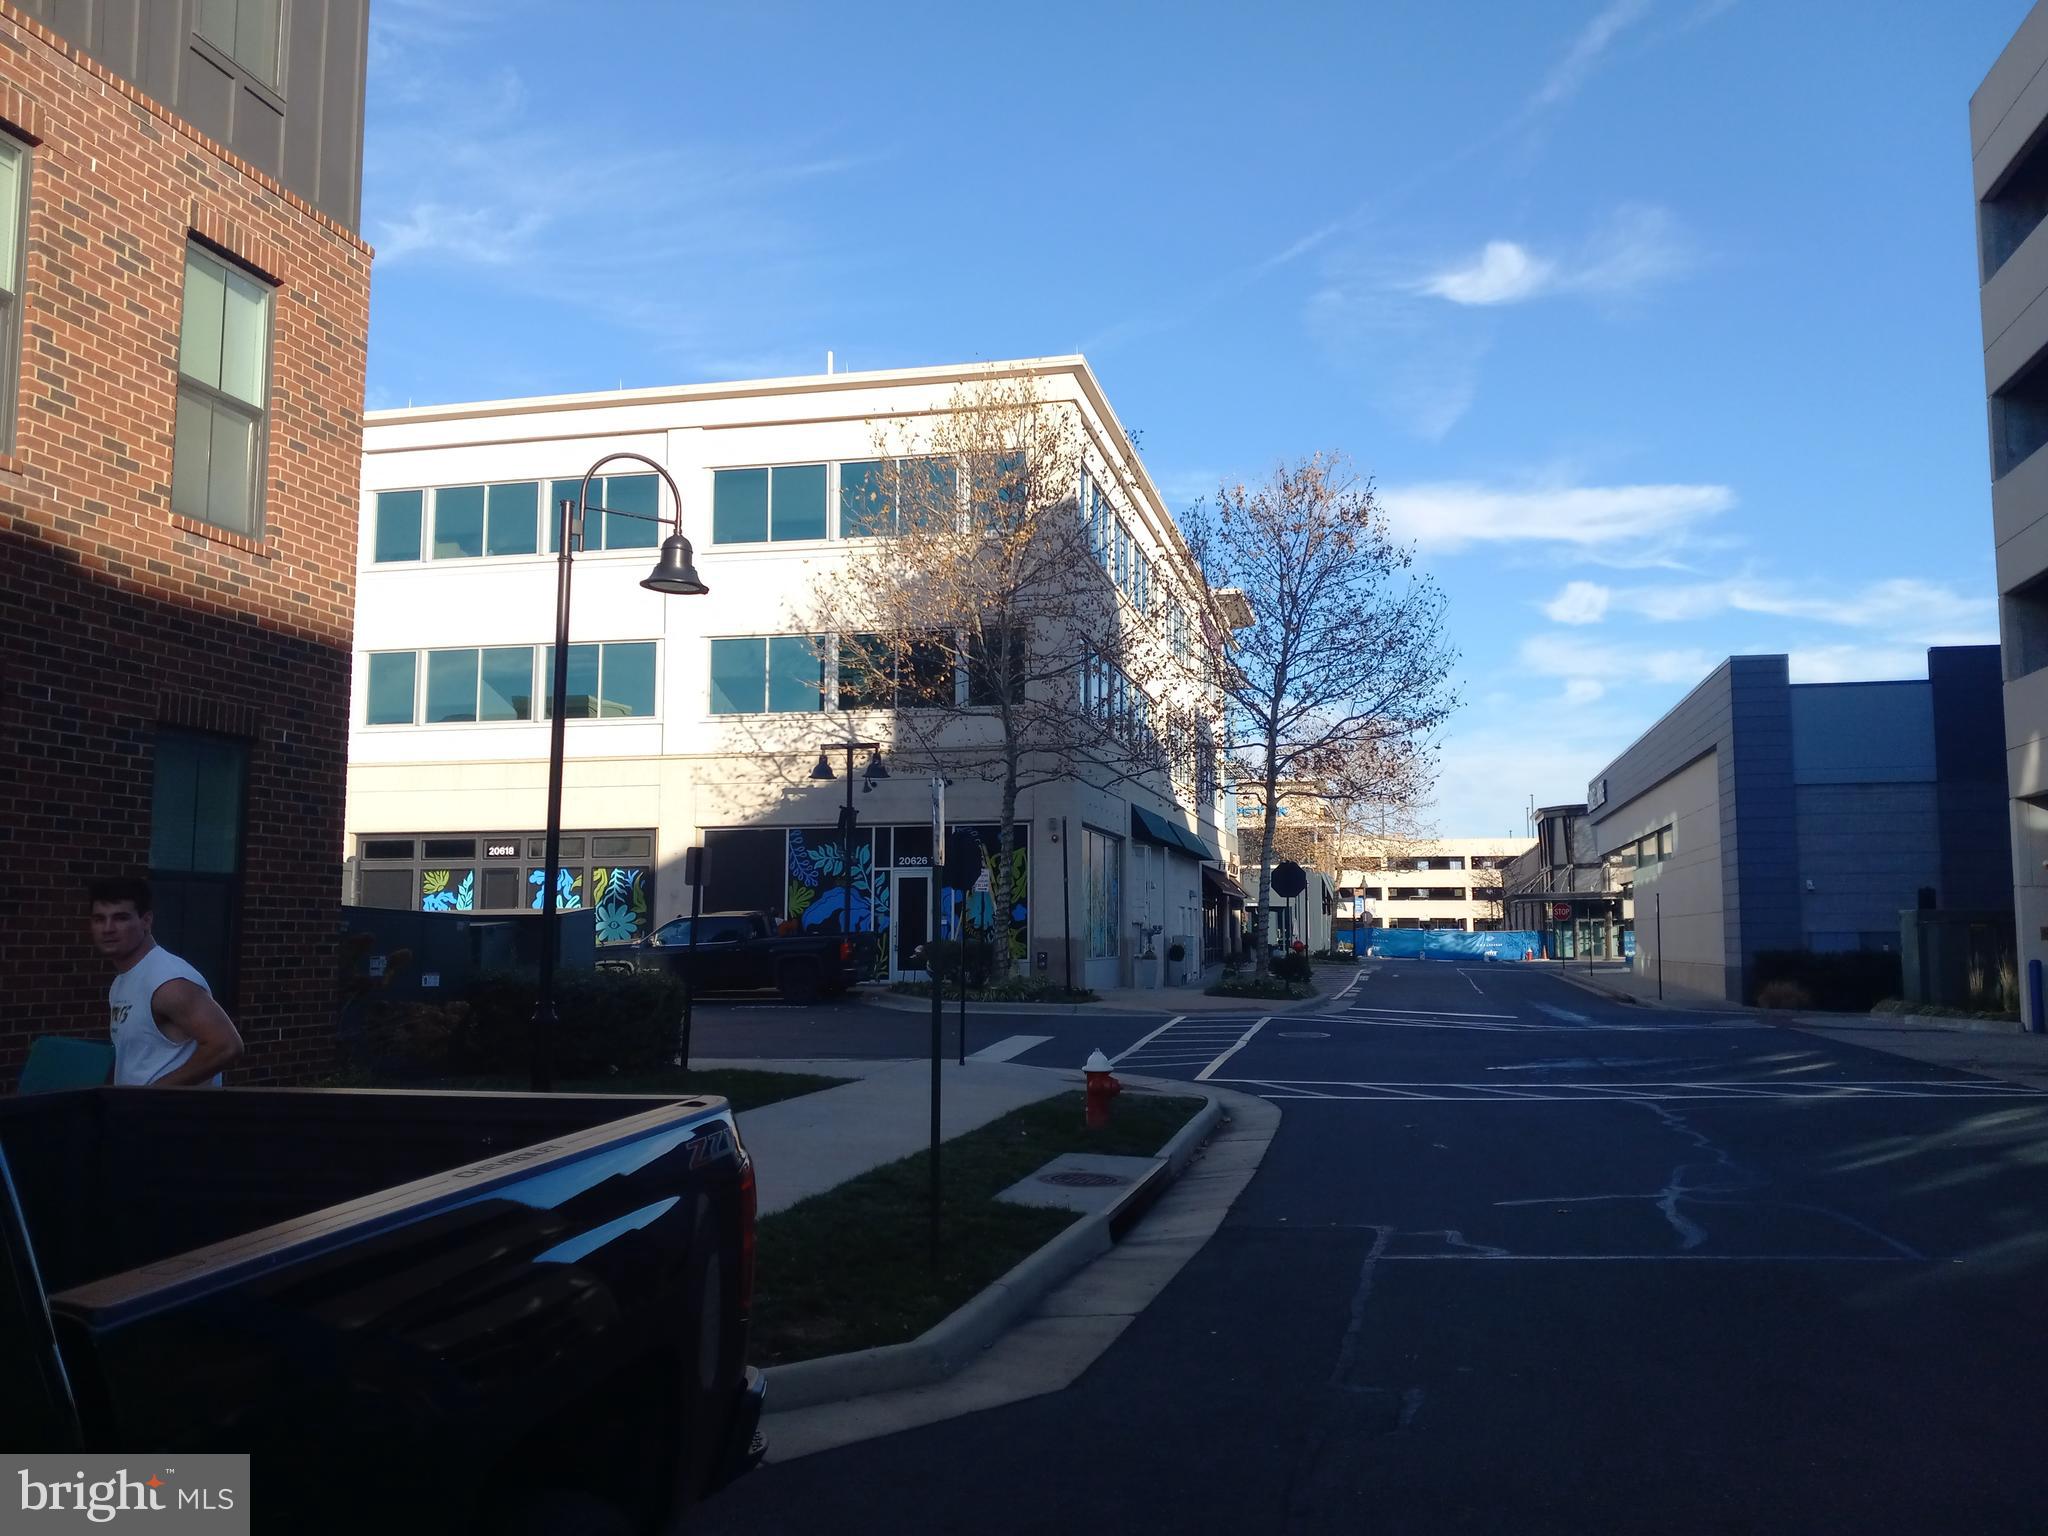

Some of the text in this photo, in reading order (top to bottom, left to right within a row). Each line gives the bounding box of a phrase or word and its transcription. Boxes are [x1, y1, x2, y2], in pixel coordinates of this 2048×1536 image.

[488, 846, 515, 856] 20618
[898, 856, 929, 866] 20626
[1554, 908, 1570, 916] STOP
[453, 1145, 562, 1178] CHEVROLET
